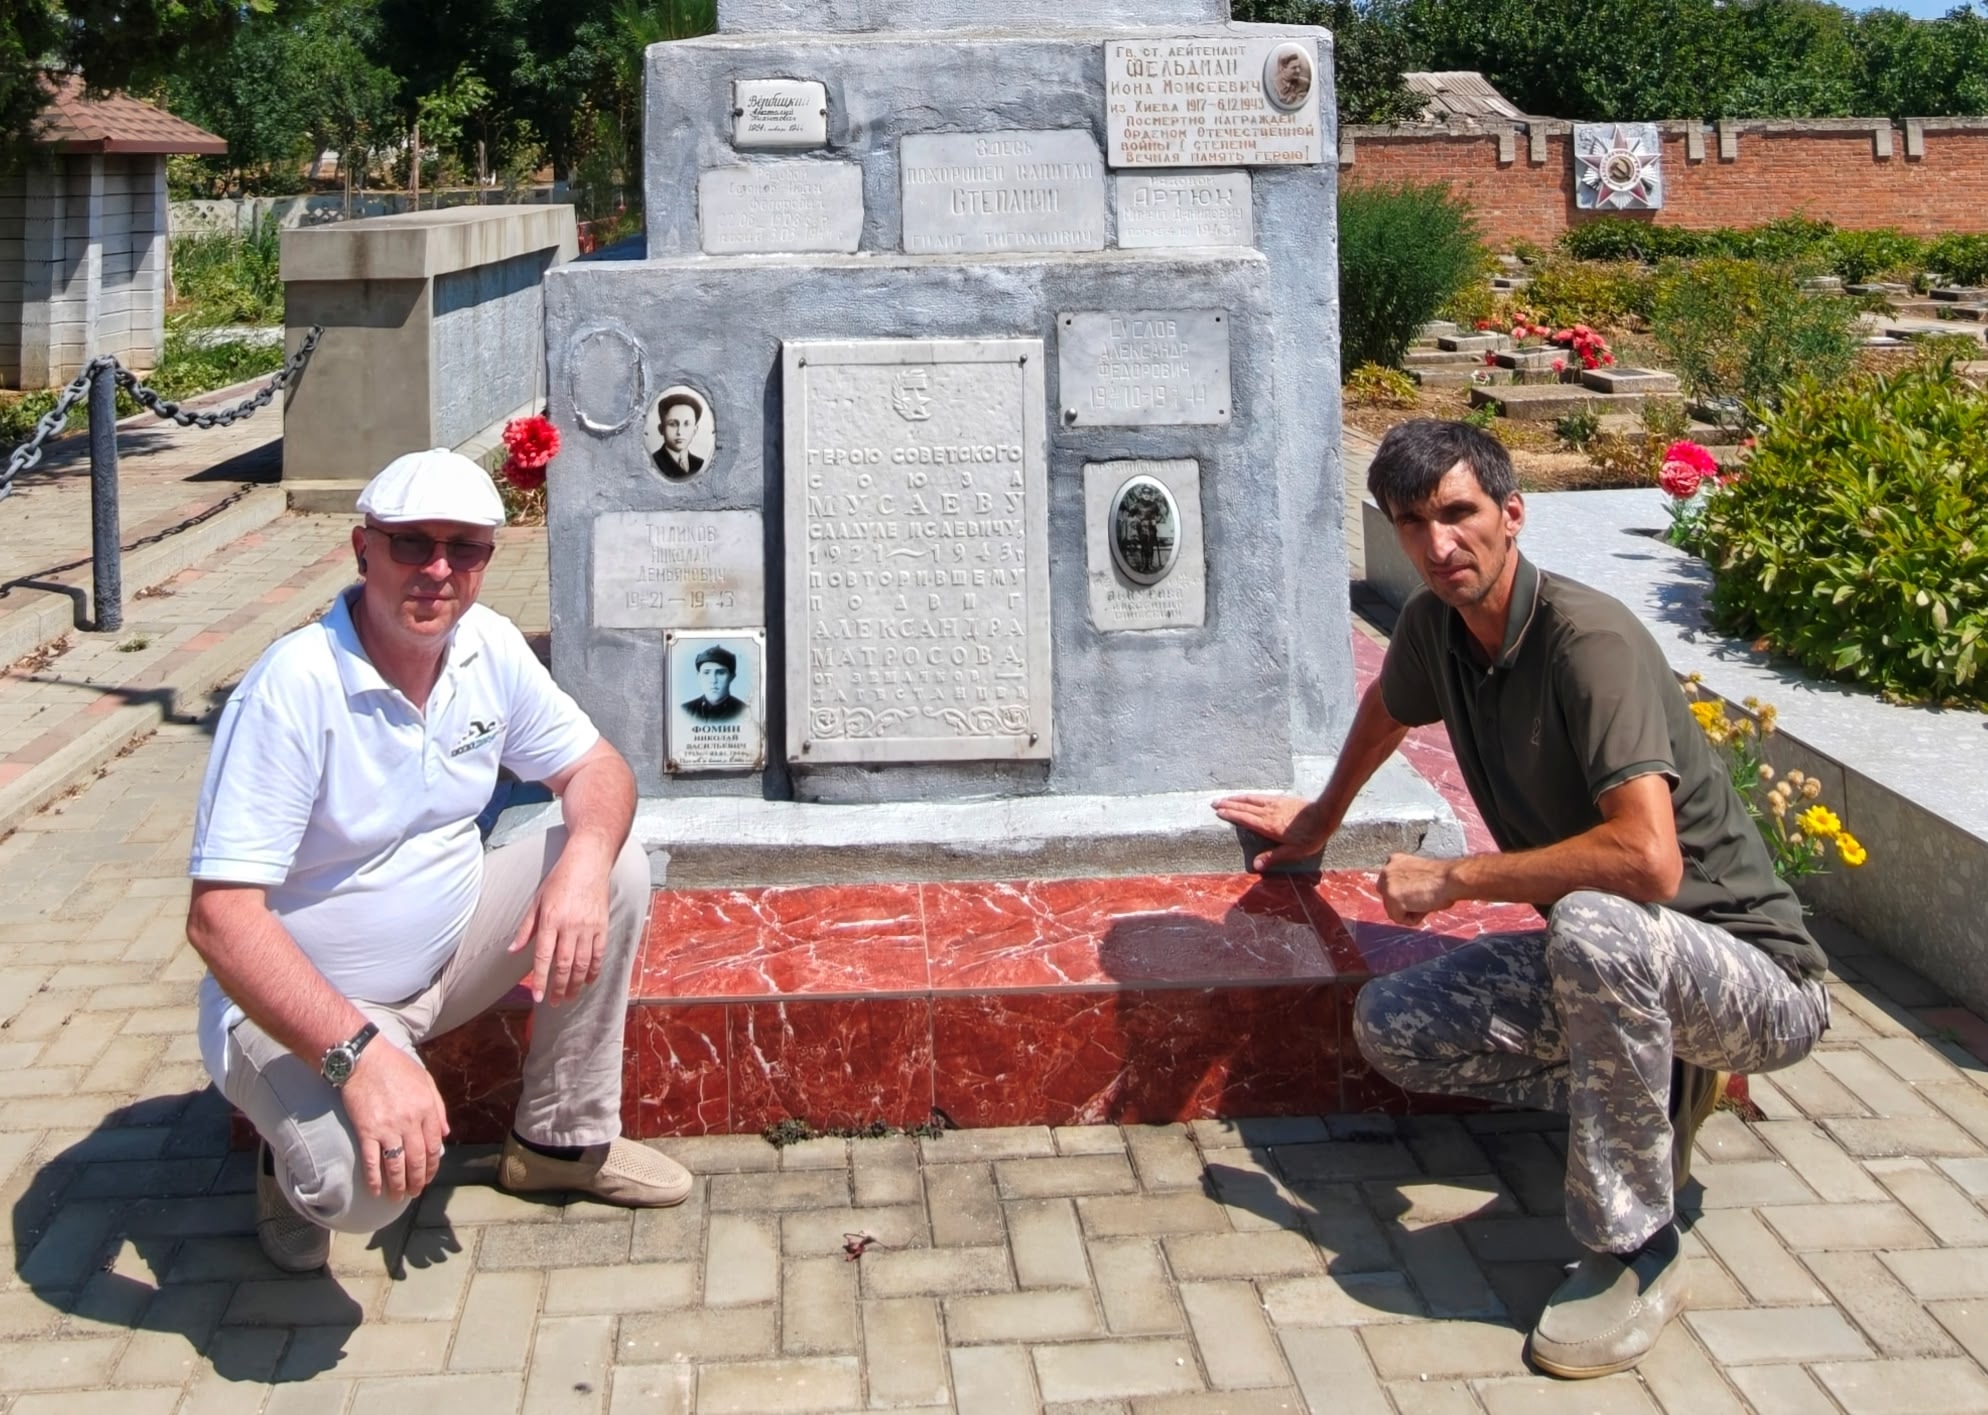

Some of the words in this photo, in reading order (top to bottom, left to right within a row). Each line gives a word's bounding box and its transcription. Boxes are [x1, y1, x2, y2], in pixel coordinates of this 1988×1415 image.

[1126, 59, 1238, 78] ФЕЛЬДМАН
[1134, 187, 1233, 207] АРТЮК
[1109, 319, 1177, 339] СУСЛОВ
[1099, 341, 1189, 361] АЛЕКСАНДР
[1097, 361, 1190, 380] ФЕДОРОВИЧ
[807, 447, 883, 465] ГЕРОЮ
[891, 445, 1023, 464] СОВЕТСКОГО
[808, 491, 1025, 518] МУСАЕВУ
[811, 617, 1025, 641] АЛЕКСАНДРА
[692, 725, 740, 733] ФОМИН
[694, 734, 739, 742] НИКОЛАЙ
